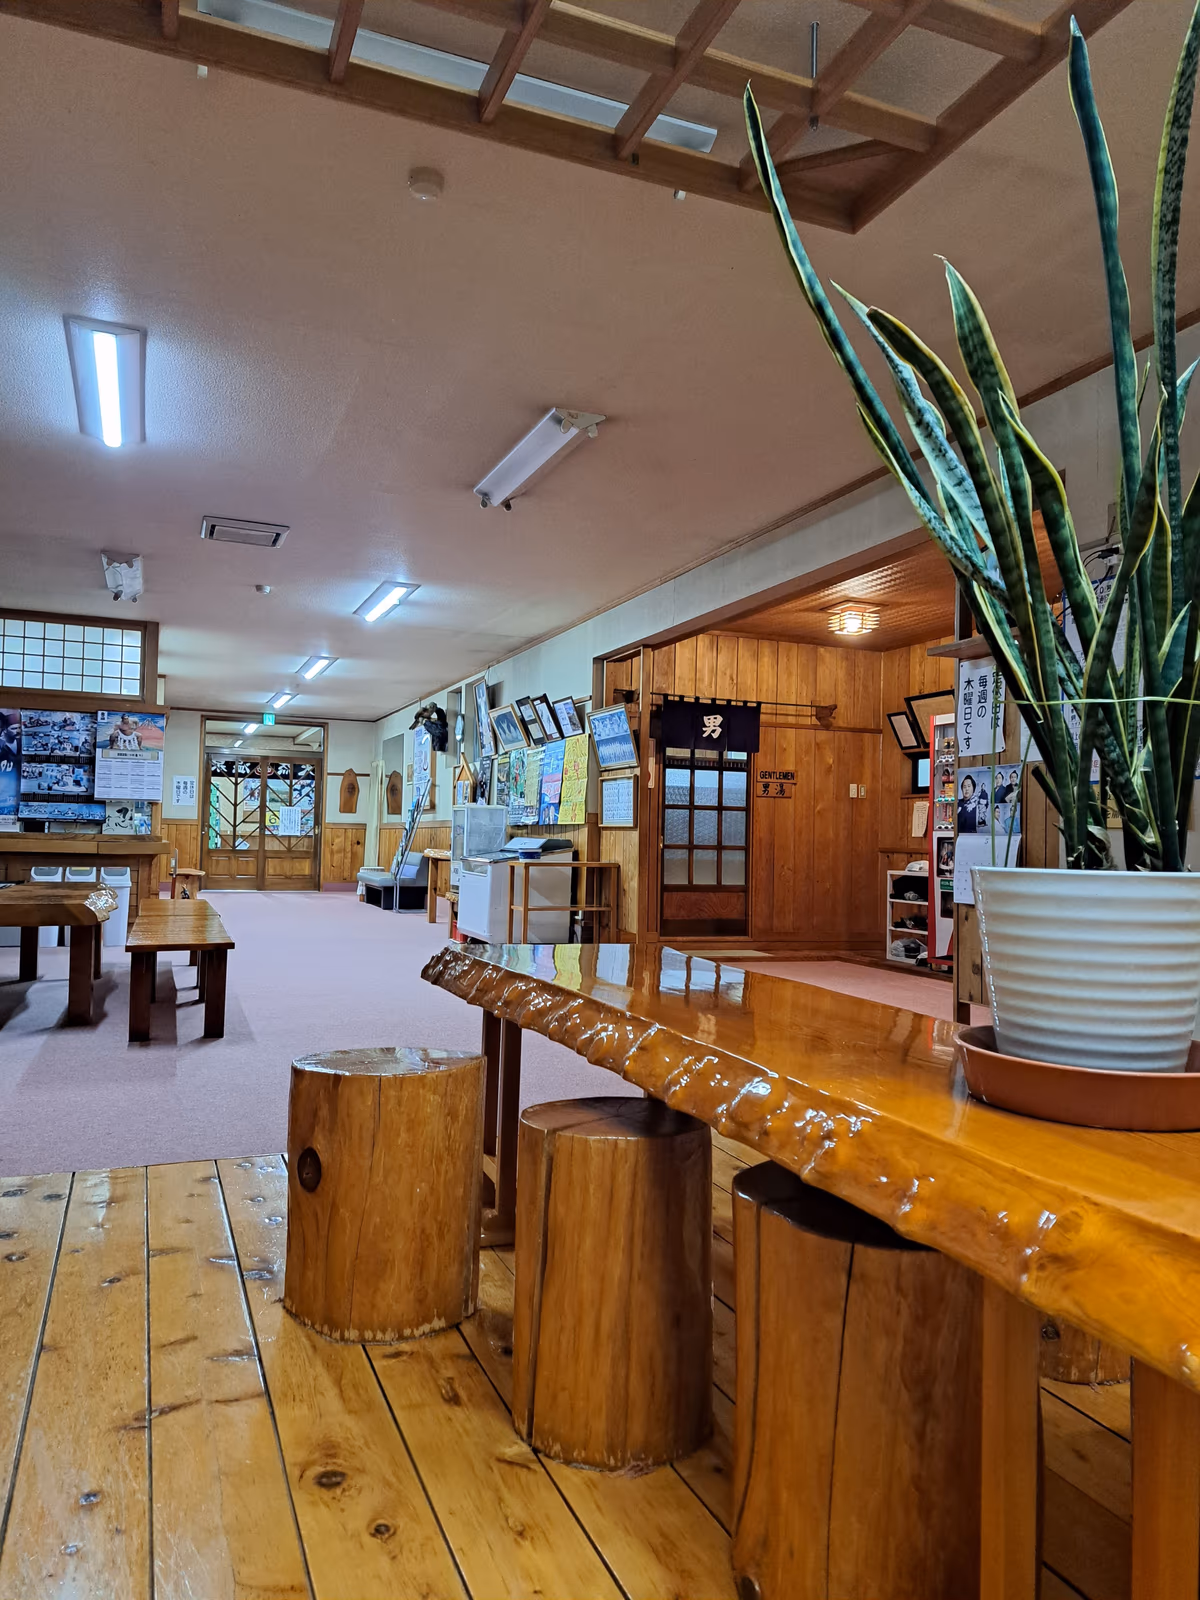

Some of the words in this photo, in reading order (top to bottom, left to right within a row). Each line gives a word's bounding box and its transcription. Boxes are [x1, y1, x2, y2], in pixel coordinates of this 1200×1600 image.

[963, 677, 974, 750] 木曜日です
[977, 675, 988, 718] 毎週の
[702, 714, 723, 739] 男
[759, 771, 795, 781] GENTLEMEN
